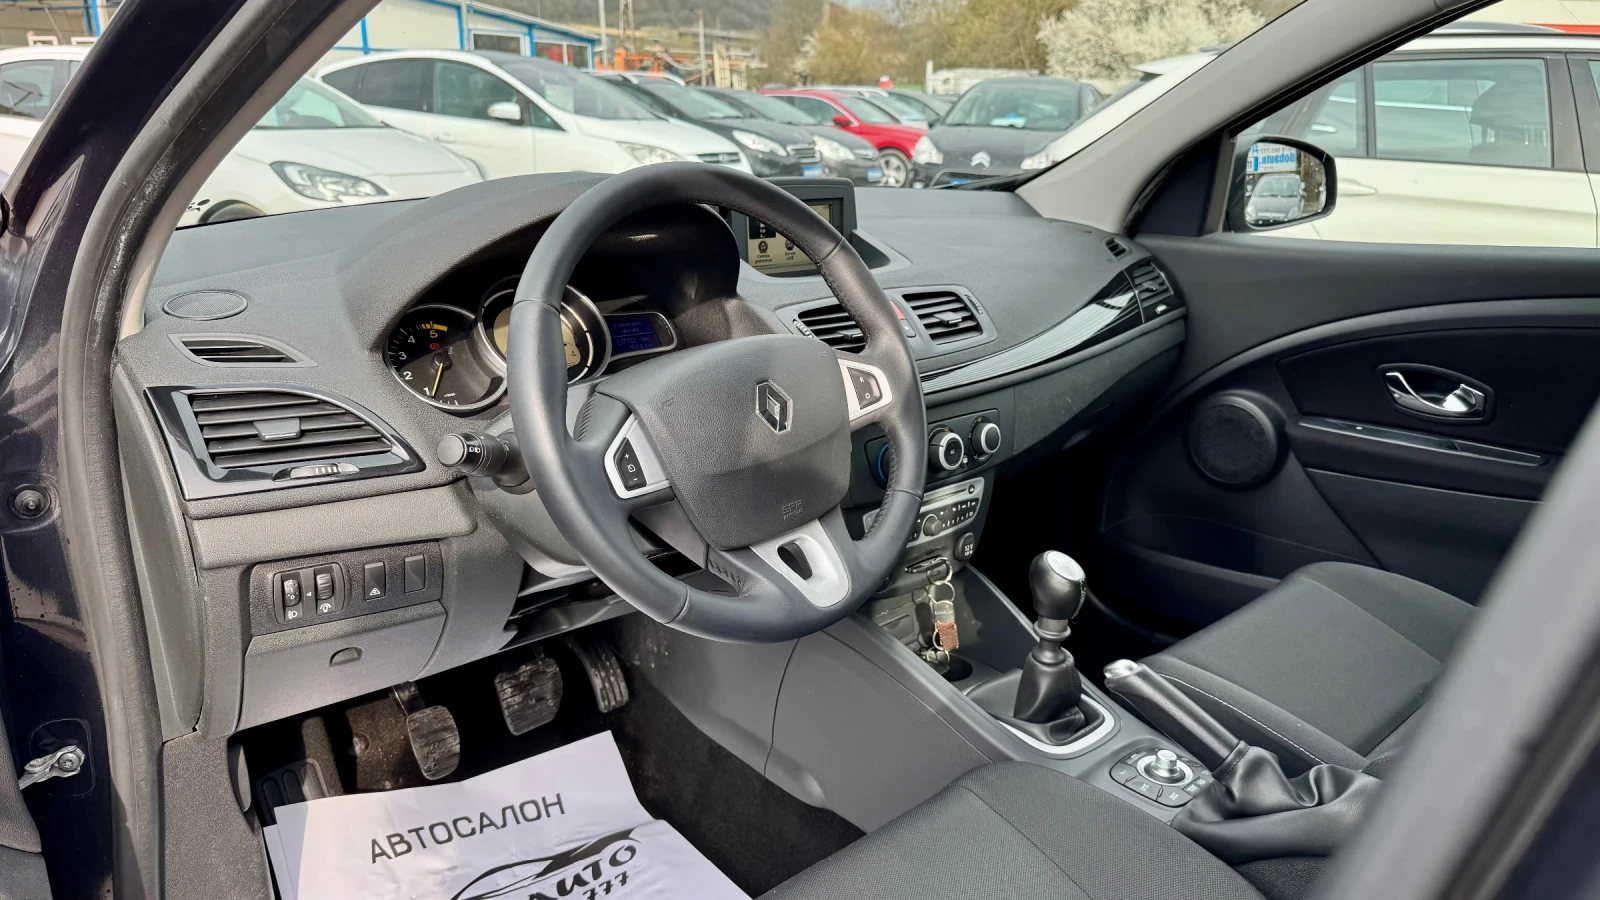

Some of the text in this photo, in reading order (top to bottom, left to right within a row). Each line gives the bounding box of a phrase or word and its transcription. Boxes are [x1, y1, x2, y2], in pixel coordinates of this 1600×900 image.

[429, 330, 438, 339] 5
[407, 335, 416, 344] 4
[398, 351, 407, 360] 3
[403, 371, 413, 380] 2
[423, 387, 430, 396] 1
[371, 793, 566, 865] АВТОСАЛОН
